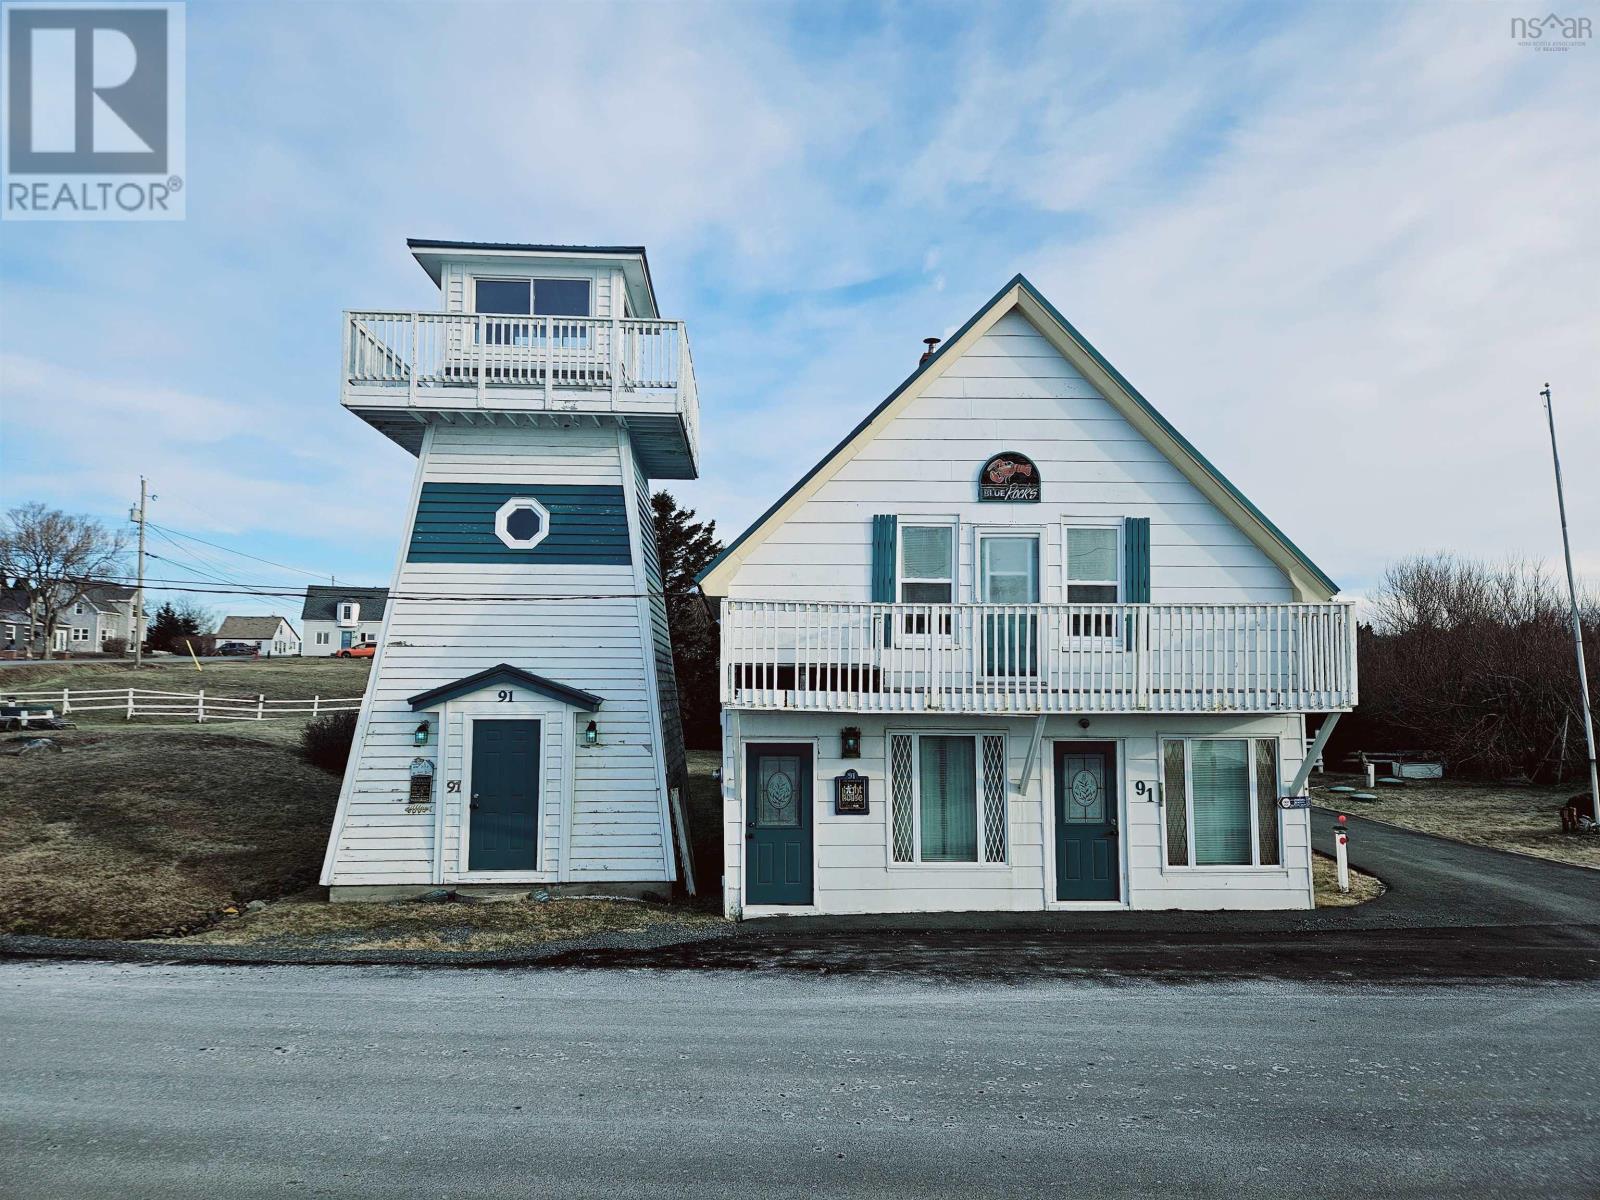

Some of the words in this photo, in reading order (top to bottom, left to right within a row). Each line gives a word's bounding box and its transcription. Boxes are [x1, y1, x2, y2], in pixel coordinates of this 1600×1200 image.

[983, 488, 1006, 497] BLUE
[498, 690, 514, 702] 91
[446, 780, 462, 793] 91
[1135, 780, 1154, 802] 91
